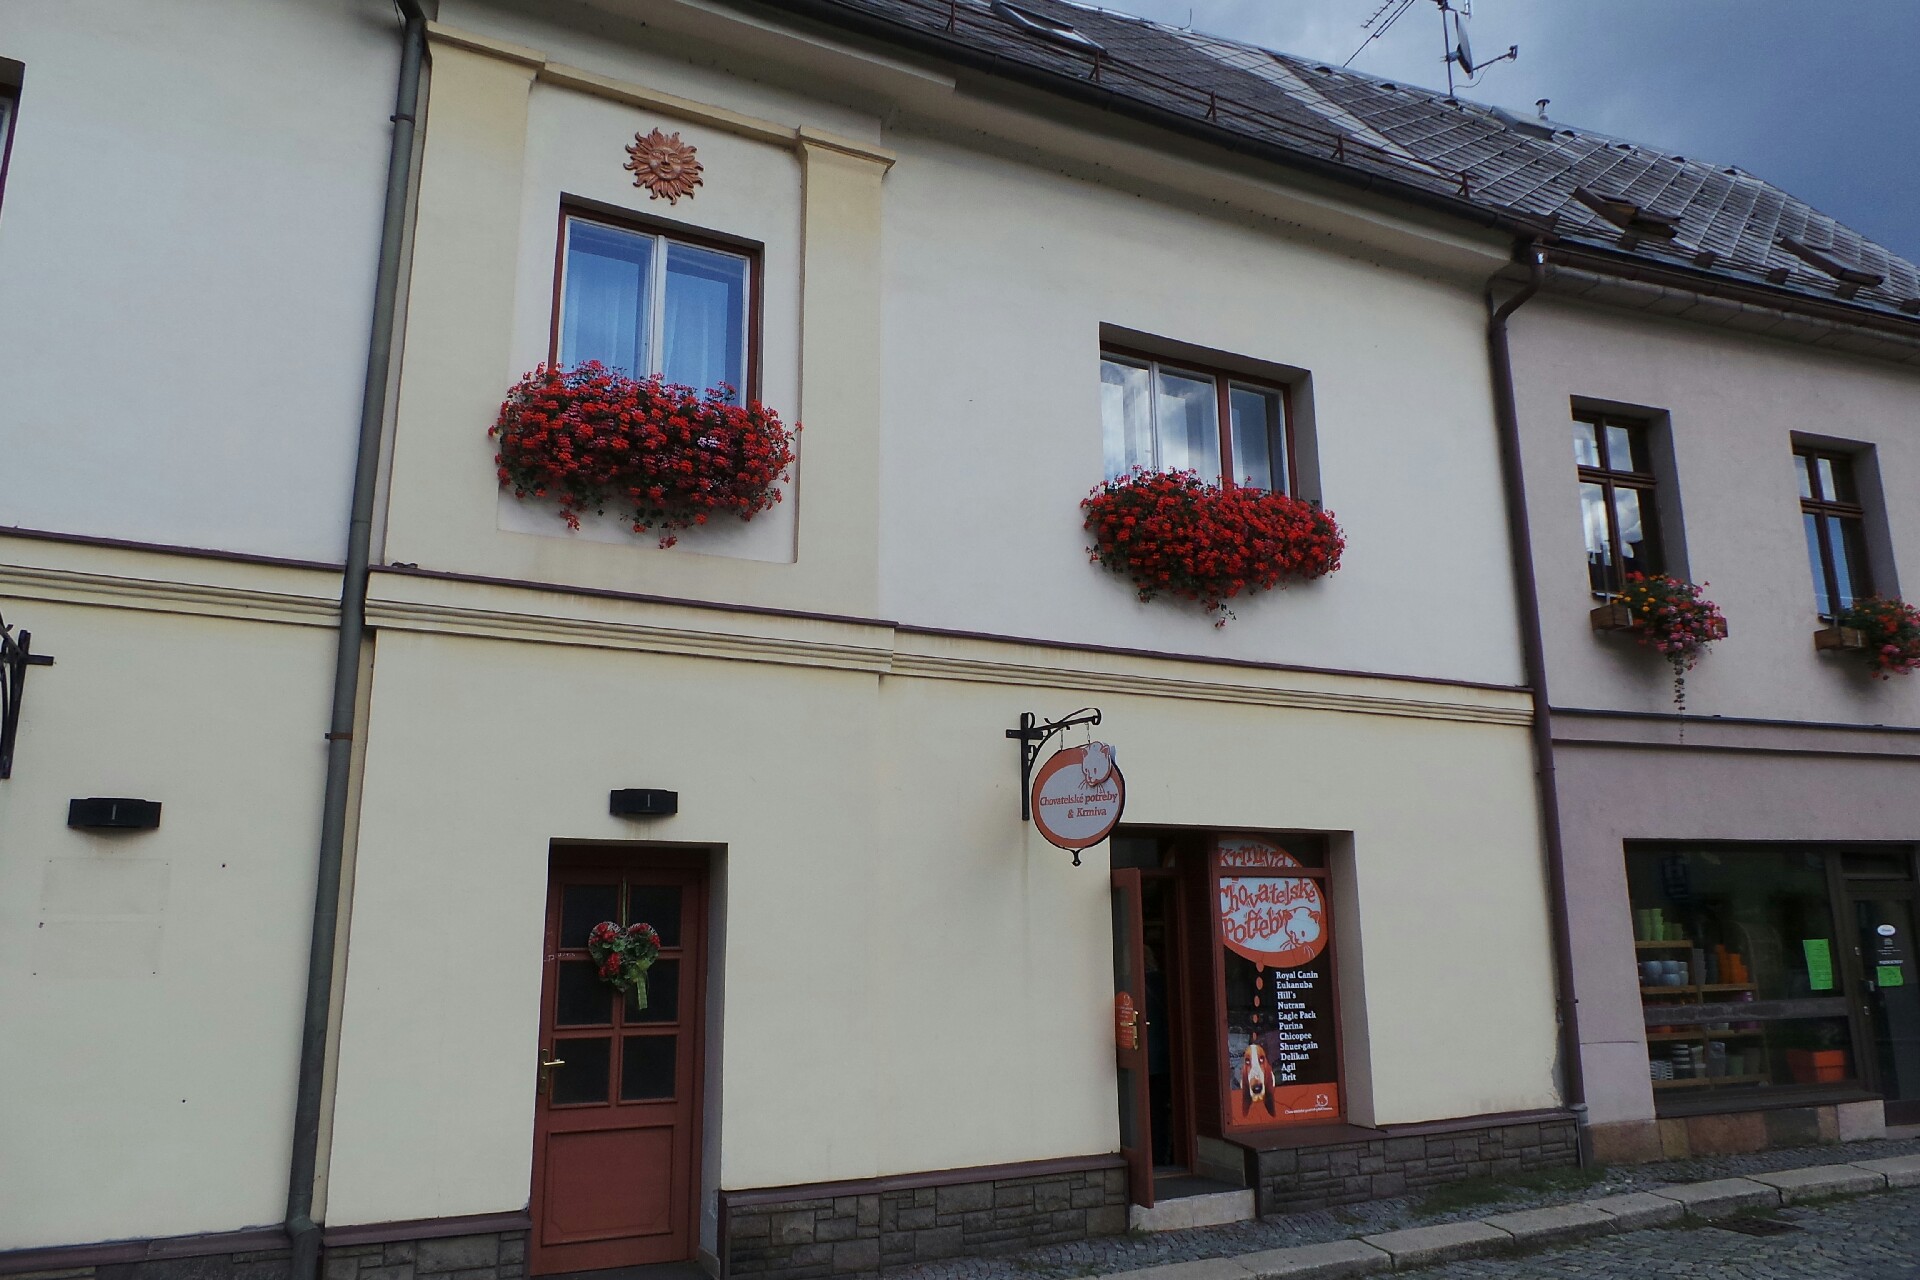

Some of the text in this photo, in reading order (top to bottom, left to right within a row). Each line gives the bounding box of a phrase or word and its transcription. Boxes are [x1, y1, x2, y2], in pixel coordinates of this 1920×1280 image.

[1040, 794, 1084, 806] Chovatelské
[1068, 807, 1107, 818] & Krmiva
[1276, 970, 1319, 981] Royal Canin
[1276, 981, 1313, 989] Eukanuba
[1277, 991, 1297, 1000] Hill's
[1277, 1001, 1306, 1010] Nutram
[1278, 1010, 1317, 1021] Eagle Pack
[1279, 1022, 1303, 1030] Purina
[1279, 1032, 1312, 1041] Chicopee
[1280, 1052, 1309, 1061] Delikan
[1281, 1062, 1296, 1072] Agil
[1282, 1073, 1297, 1081] Brit
